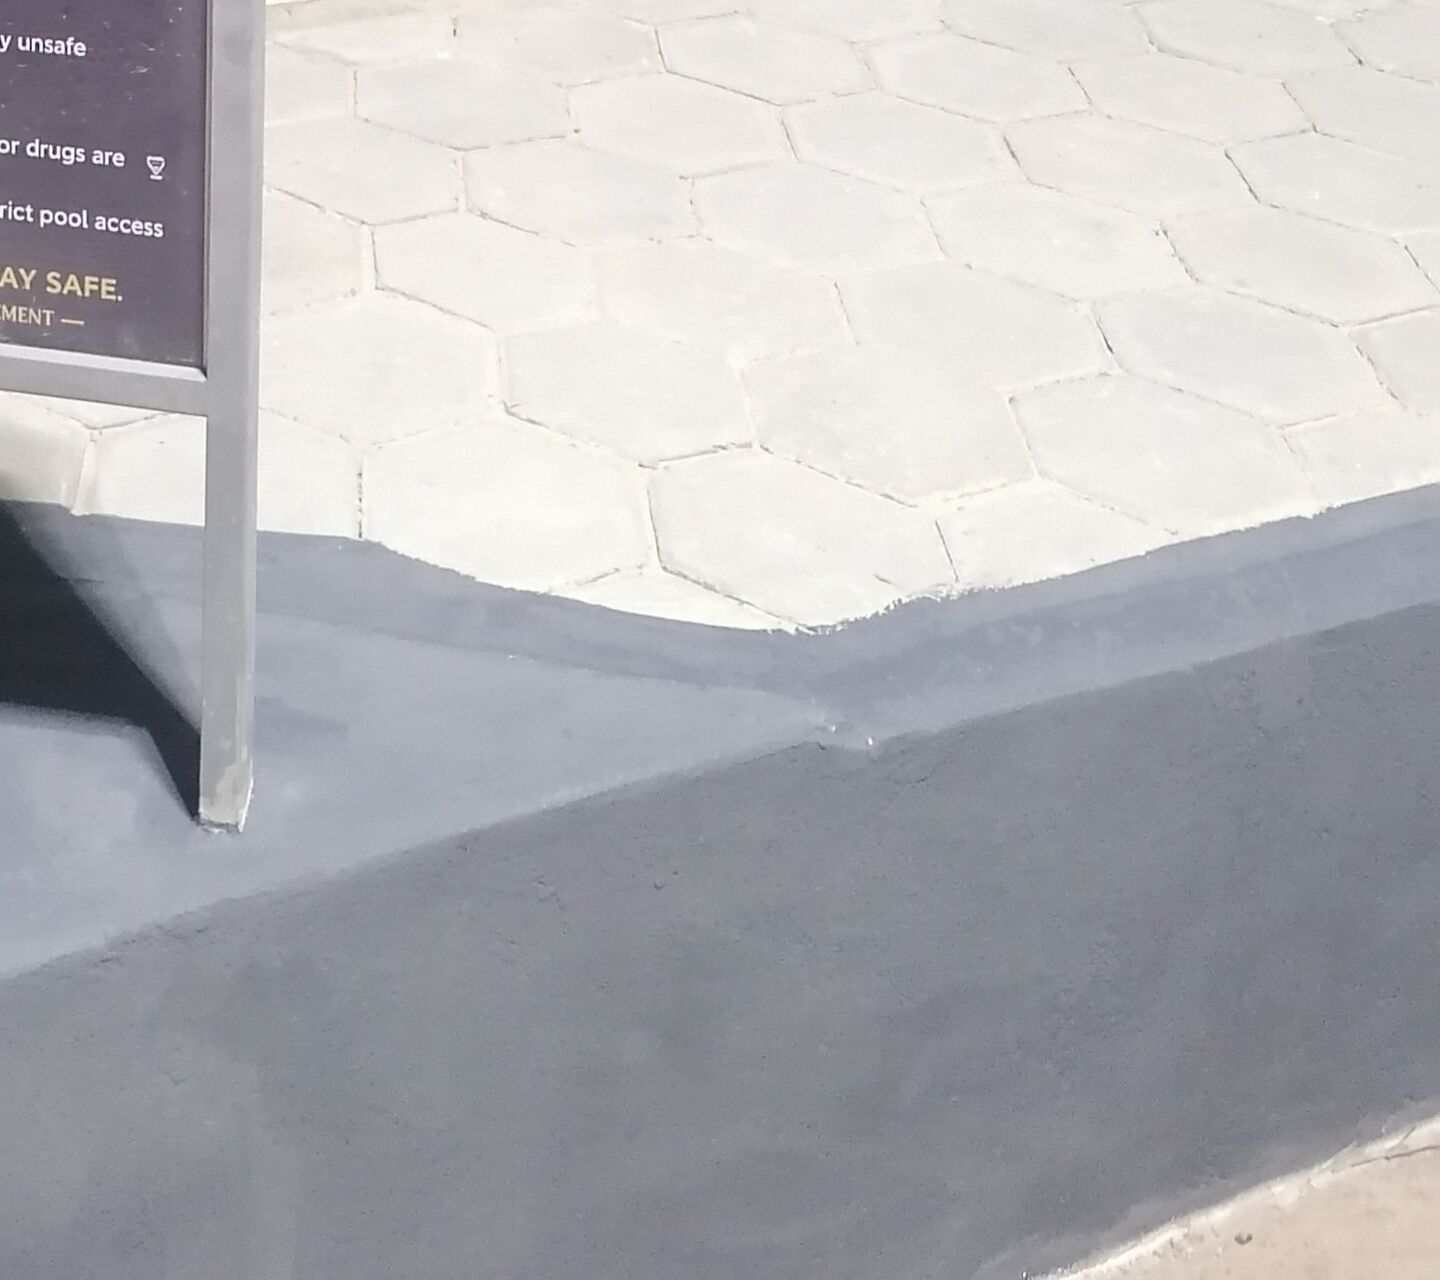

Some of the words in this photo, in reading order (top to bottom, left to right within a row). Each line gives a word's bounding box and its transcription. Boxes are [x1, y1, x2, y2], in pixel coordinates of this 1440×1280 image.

[17, 35, 87, 58] unsafe
[25, 137, 87, 166] drugs
[91, 149, 126, 168] are
[39, 208, 89, 230] pool
[94, 215, 164, 239] access
[45, 270, 123, 302] SAFE.
